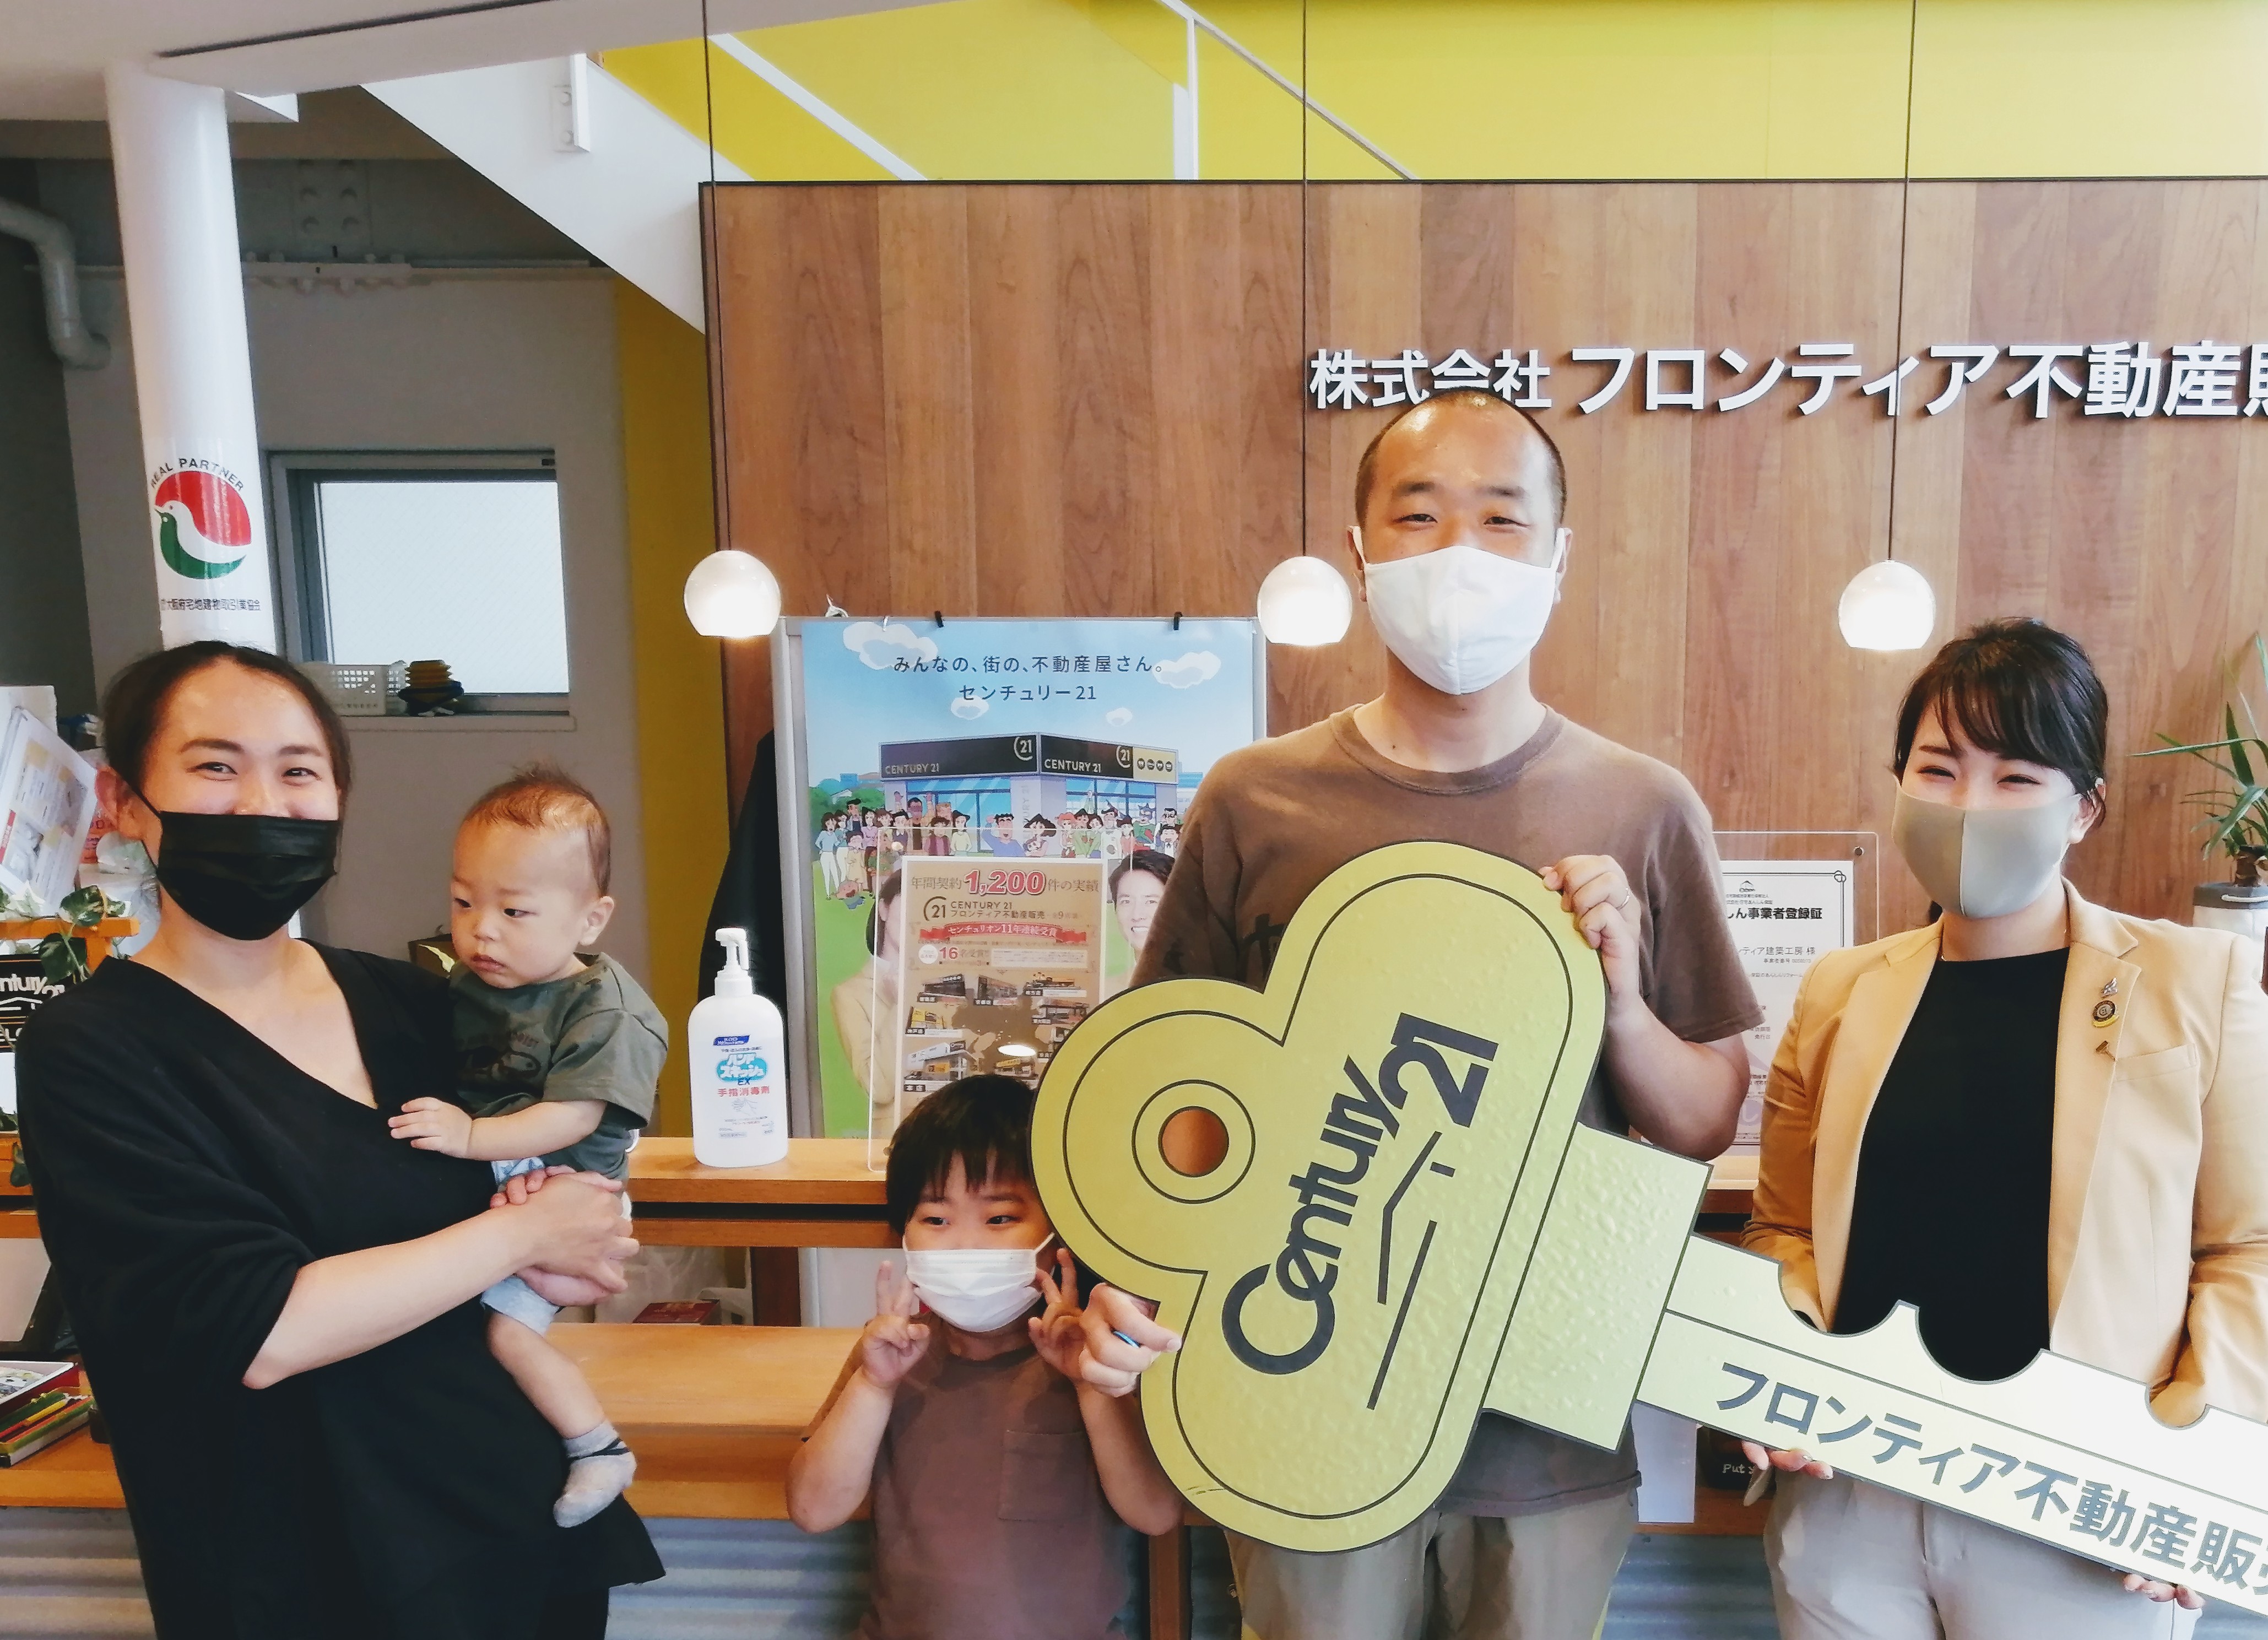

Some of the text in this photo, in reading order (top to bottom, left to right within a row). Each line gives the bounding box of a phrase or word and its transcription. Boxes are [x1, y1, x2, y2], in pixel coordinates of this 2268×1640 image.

[1309, 348, 1552, 410] 株式会社
[150, 458, 245, 492] REAL PARTNER
[893, 654, 1162, 674] みんなの、街の、不動産屋さん。
[885, 762, 940, 775] CENTURY 21
[1044, 759, 1102, 773] CENTURY 21
[951, 901, 1013, 910] CENTURY 21
[738, 1077, 751, 1085] EX
[1722, 1464, 1745, 1474] Put
[1716, 1362, 2268, 1595] フロンティア不動産販
